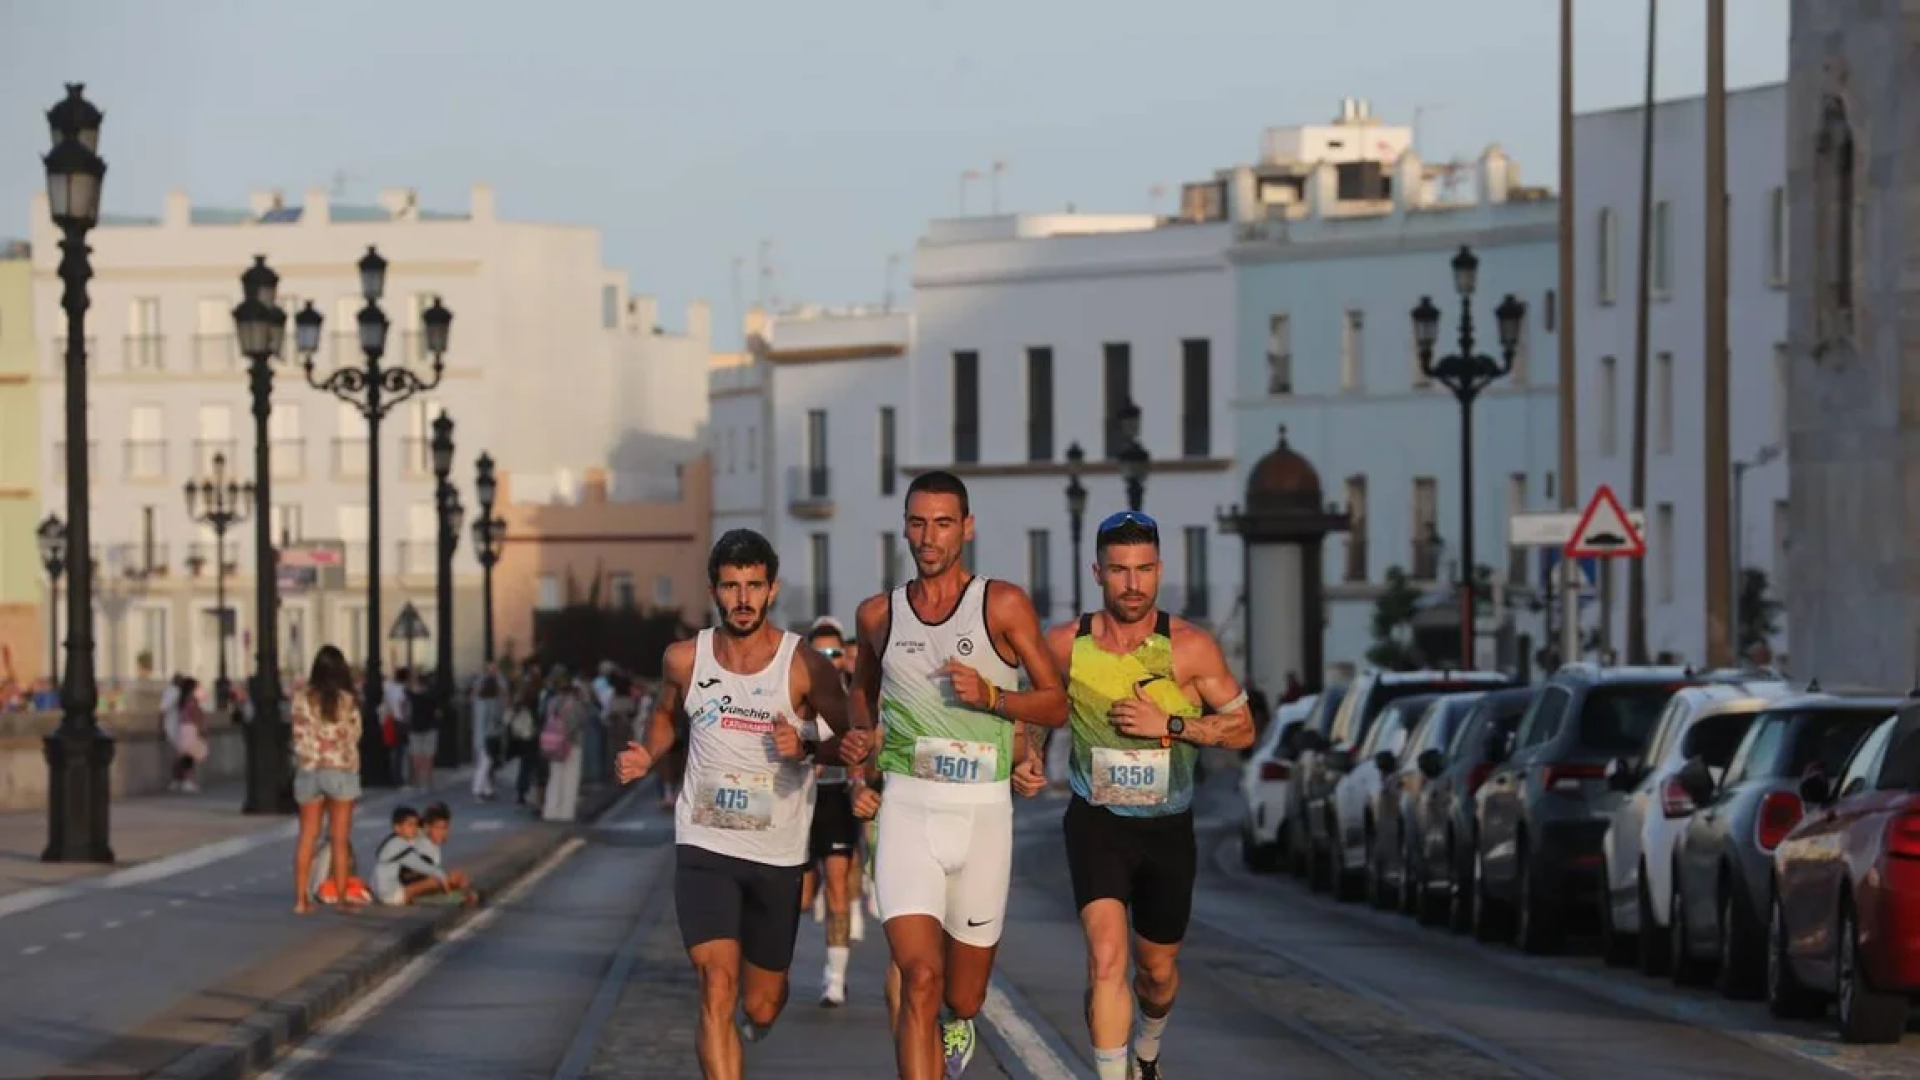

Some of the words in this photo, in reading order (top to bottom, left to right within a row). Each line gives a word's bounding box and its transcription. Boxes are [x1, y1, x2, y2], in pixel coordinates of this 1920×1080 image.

[935, 755, 979, 780] 1501
[1108, 765, 1154, 786] 1358
[716, 788, 748, 809] 475
